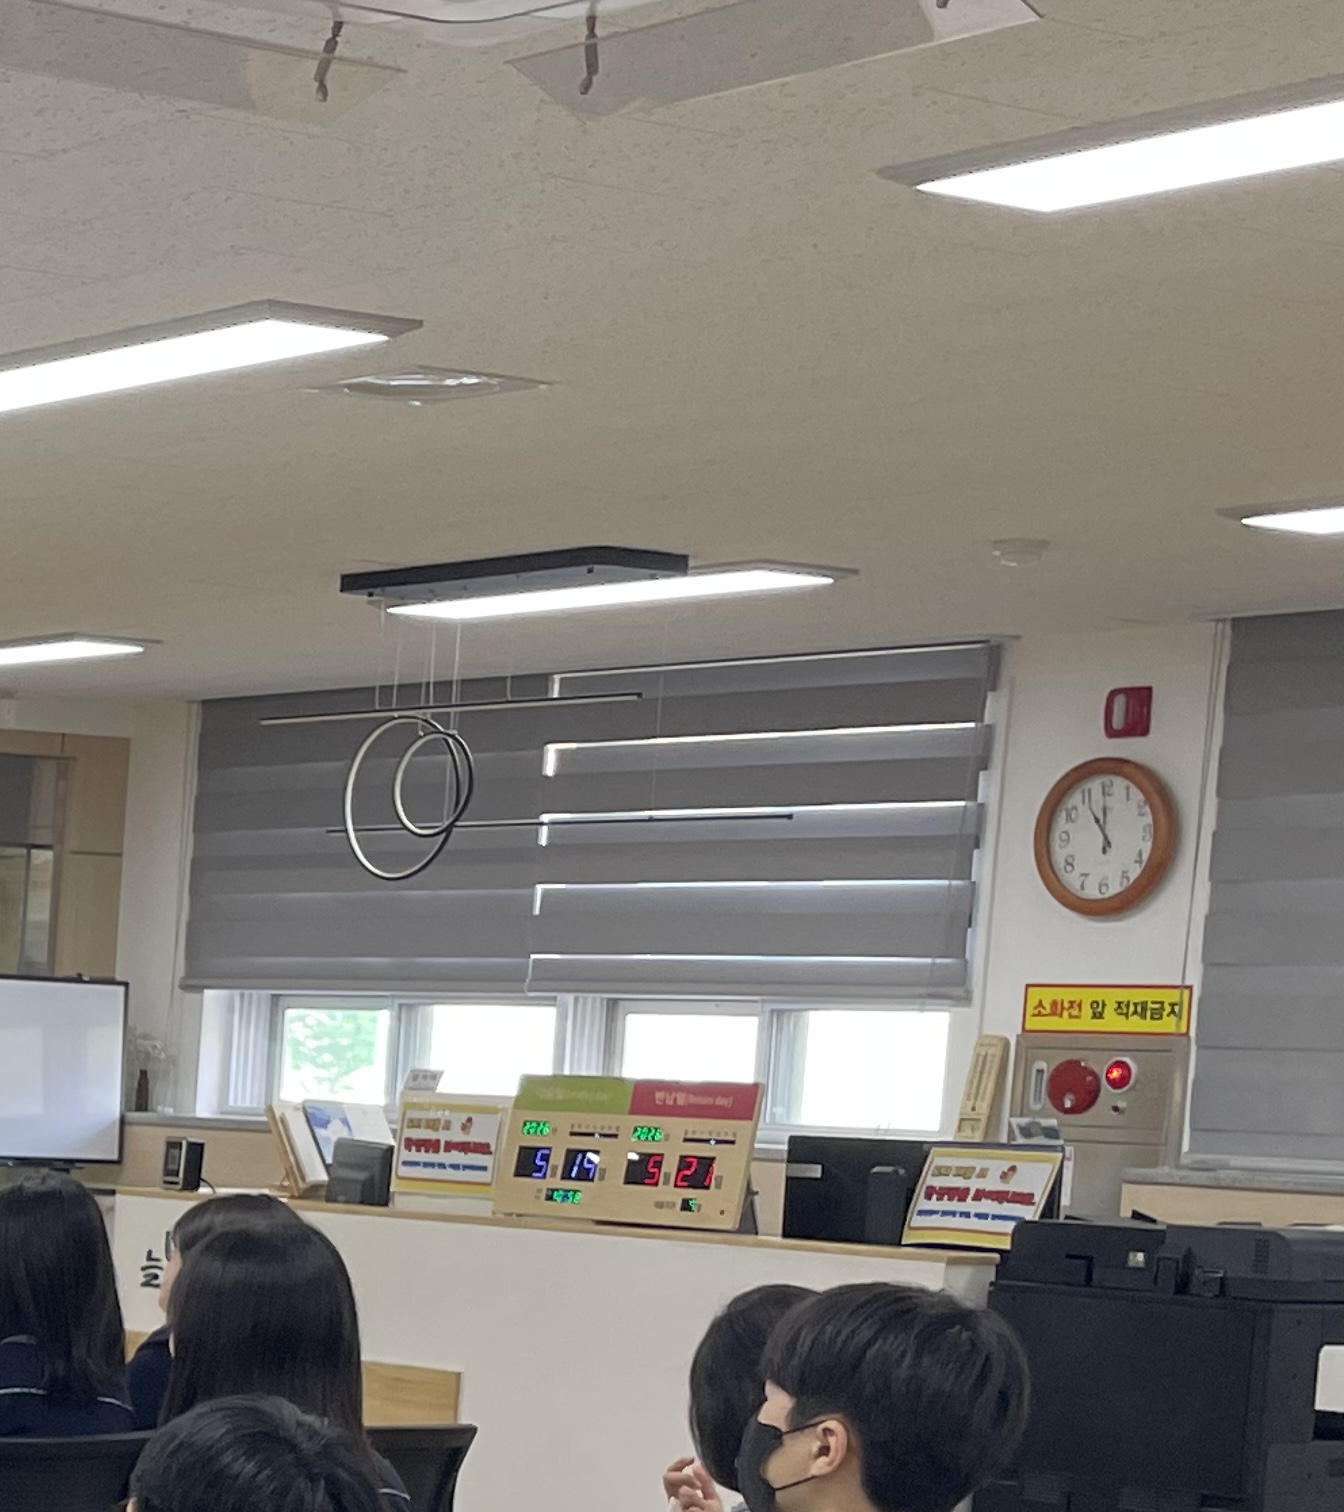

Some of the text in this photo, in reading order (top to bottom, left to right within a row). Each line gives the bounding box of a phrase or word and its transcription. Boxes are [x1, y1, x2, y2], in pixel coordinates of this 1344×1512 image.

[1064, 806, 1078, 824] 10
[1059, 830, 1070, 849] 9
[1064, 854, 1075, 873] 8
[1134, 849, 1143, 867] 4
[1078, 873, 1090, 891] 7
[1098, 877, 1109, 895] 6
[1119, 870, 1130, 888] 5
[1031, 998, 1182, 1021] 소화전 앞 적재금지
[532, 1149, 550, 1178] 5
[644, 1155, 662, 1184] 5
[676, 1157, 716, 1187] 21
